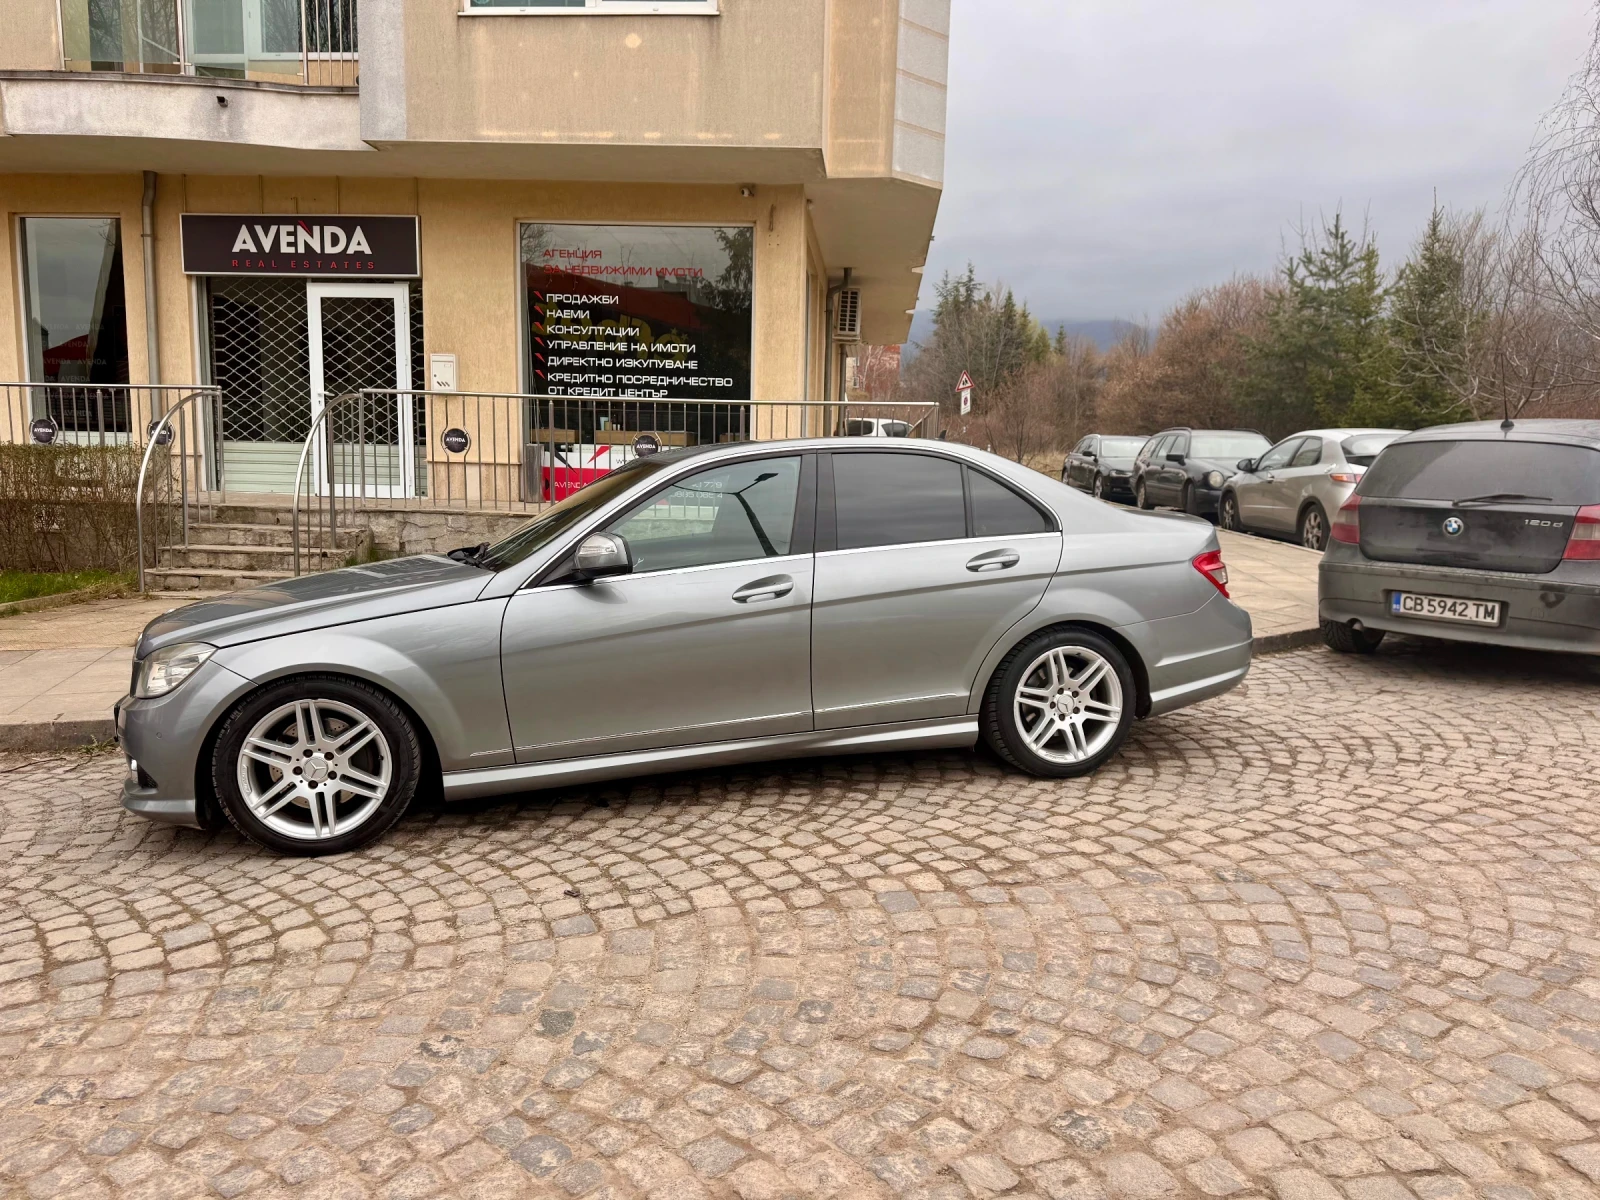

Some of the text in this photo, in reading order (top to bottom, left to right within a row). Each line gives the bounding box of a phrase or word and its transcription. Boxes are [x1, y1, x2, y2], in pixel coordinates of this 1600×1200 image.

[231, 221, 373, 255] AVENDA
[543, 249, 602, 260] АГЕНЦИЯ
[231, 259, 375, 269] REAL ESTATES
[544, 264, 703, 277] ЗА НЕДВИЖИМИ ИМОТИ
[546, 293, 619, 305] ПРОДАЖБИ
[546, 309, 590, 319] НАЕМИ
[546, 325, 640, 337] КОНСУЛТАЦИИ
[547, 340, 696, 353] УПРАВЛЕНИЕ НА ИМОТИ
[547, 356, 698, 369] ДИРЕКТНО ИЗКУПУВАНЕ
[547, 372, 733, 387] КРЕДИТНО ПОСРЕДНИЧЕСТВО
[547, 386, 668, 398] ОТ КРЕДИТ ЦЕНТЪР
[1402, 595, 1496, 621] CB 5942 TM
